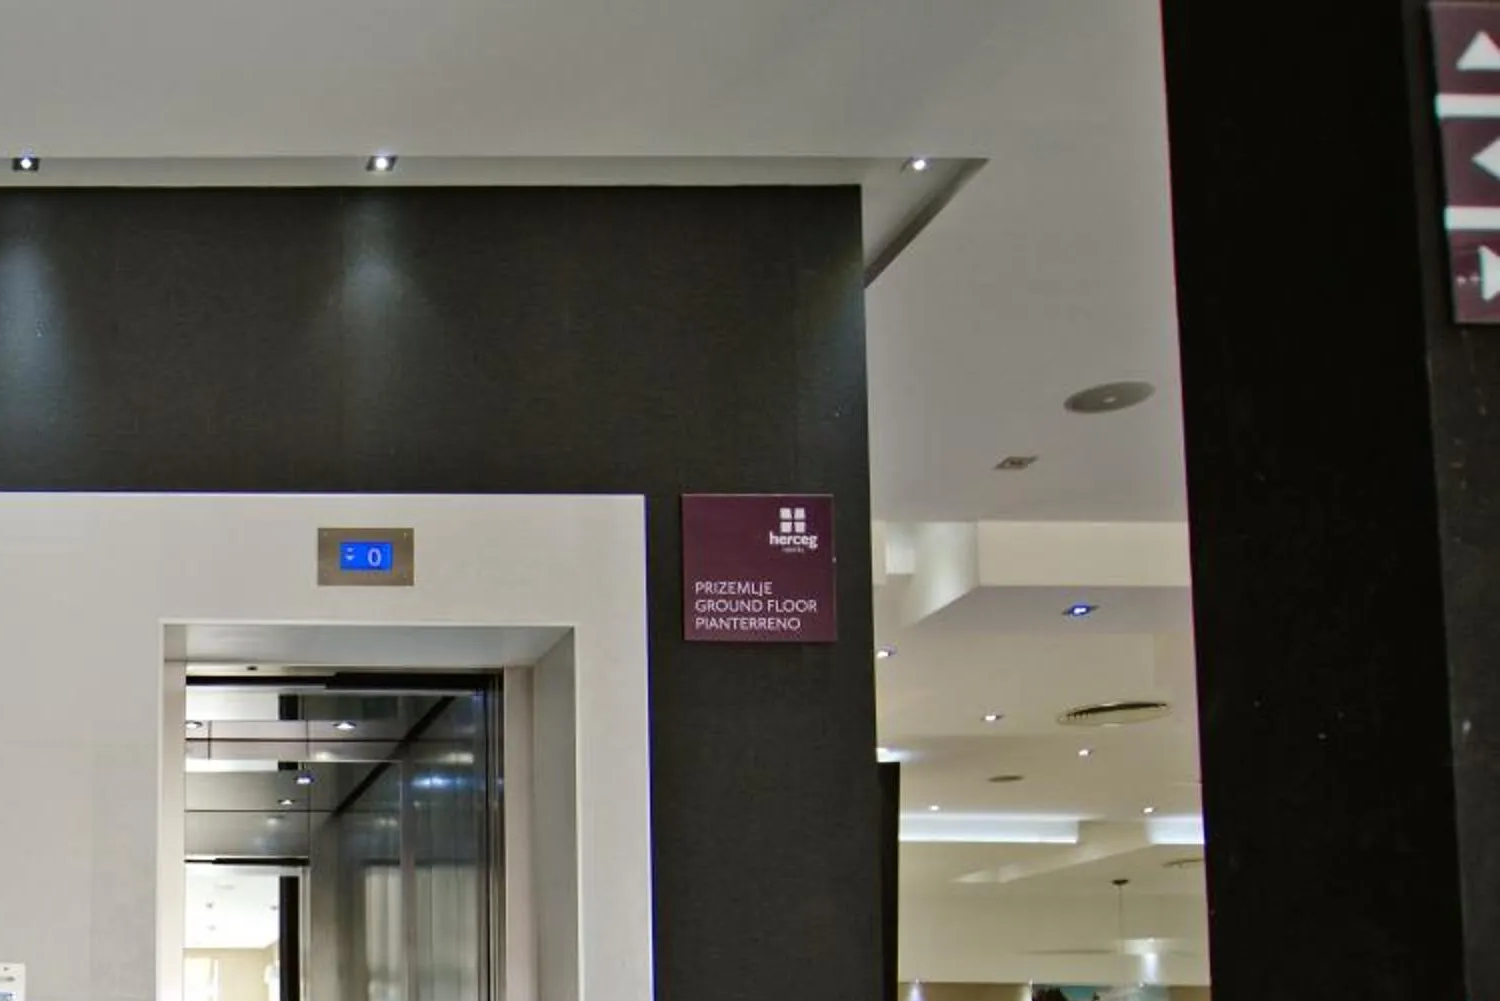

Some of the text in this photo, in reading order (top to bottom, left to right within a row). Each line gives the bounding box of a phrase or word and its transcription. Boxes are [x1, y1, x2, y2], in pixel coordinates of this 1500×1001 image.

[769, 531, 818, 549] herceg
[367, 547, 381, 566] 0
[695, 581, 773, 597] PRIZEMLJE
[695, 599, 817, 613] GROUND FLOOR
[695, 617, 801, 631] PIANTERRENO
